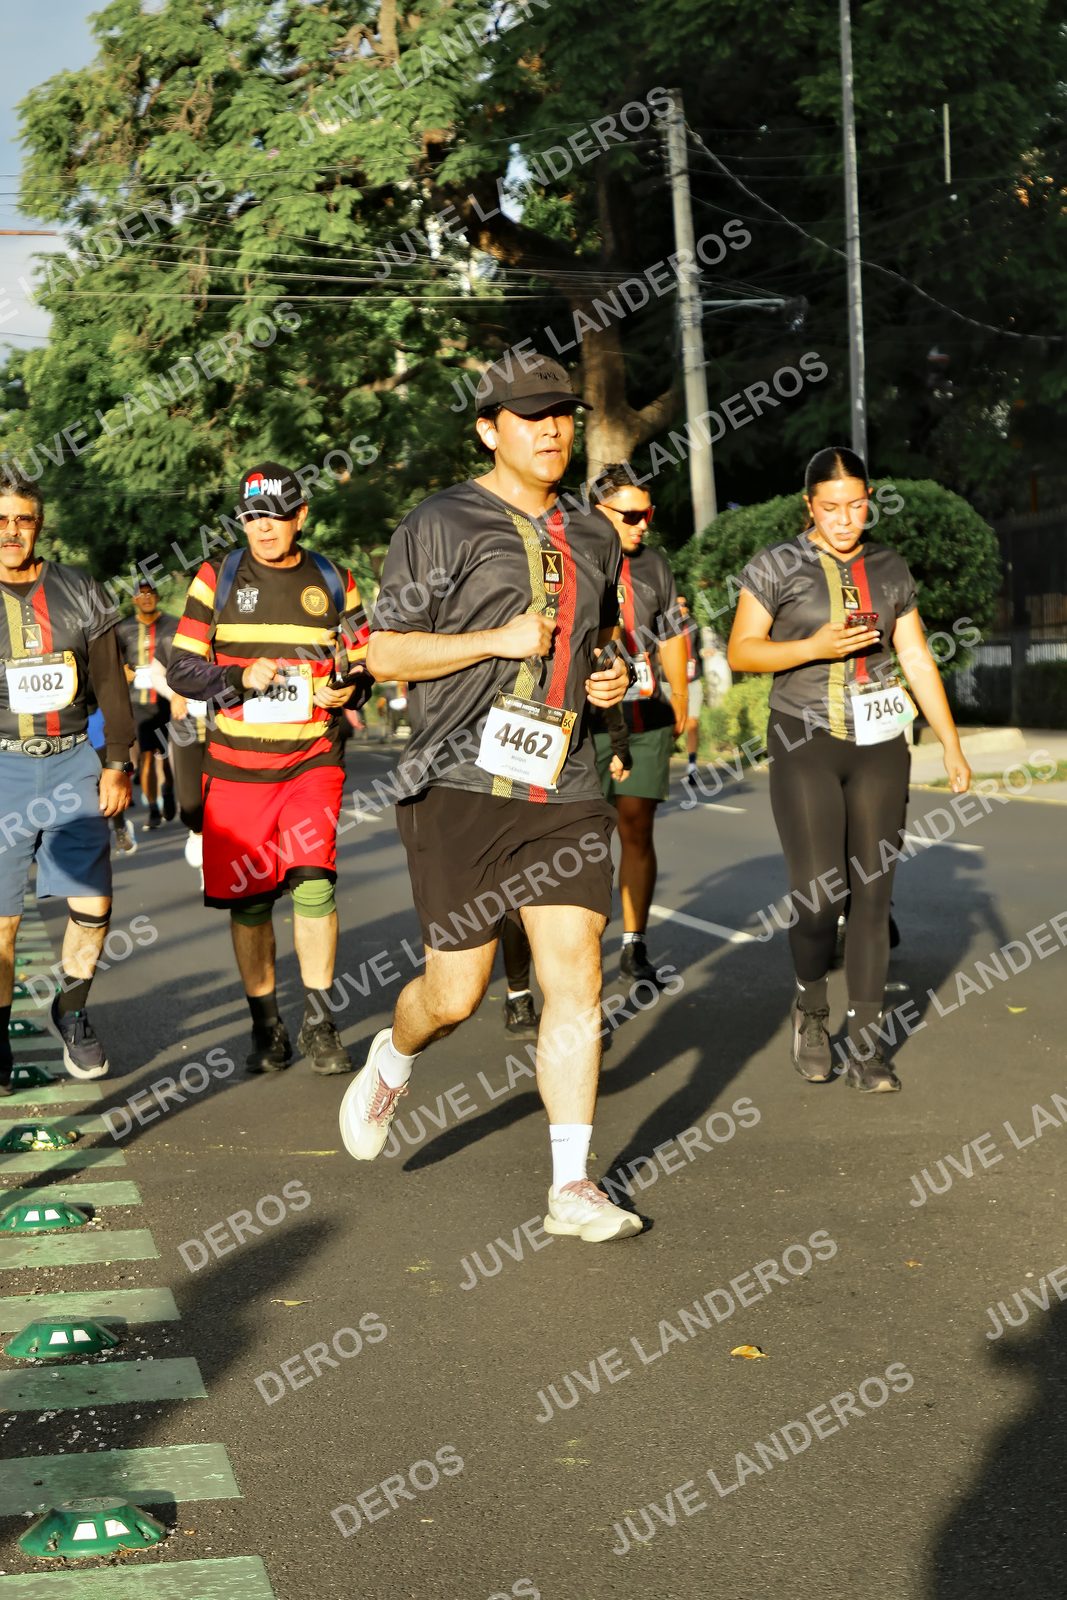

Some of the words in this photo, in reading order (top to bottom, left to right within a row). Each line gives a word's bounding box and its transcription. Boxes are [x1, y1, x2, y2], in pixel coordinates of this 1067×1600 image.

[244, 479, 282, 499] JAPAN
[18, 672, 64, 692] 4082
[864, 696, 904, 721] 7346
[494, 722, 553, 760] 4462
